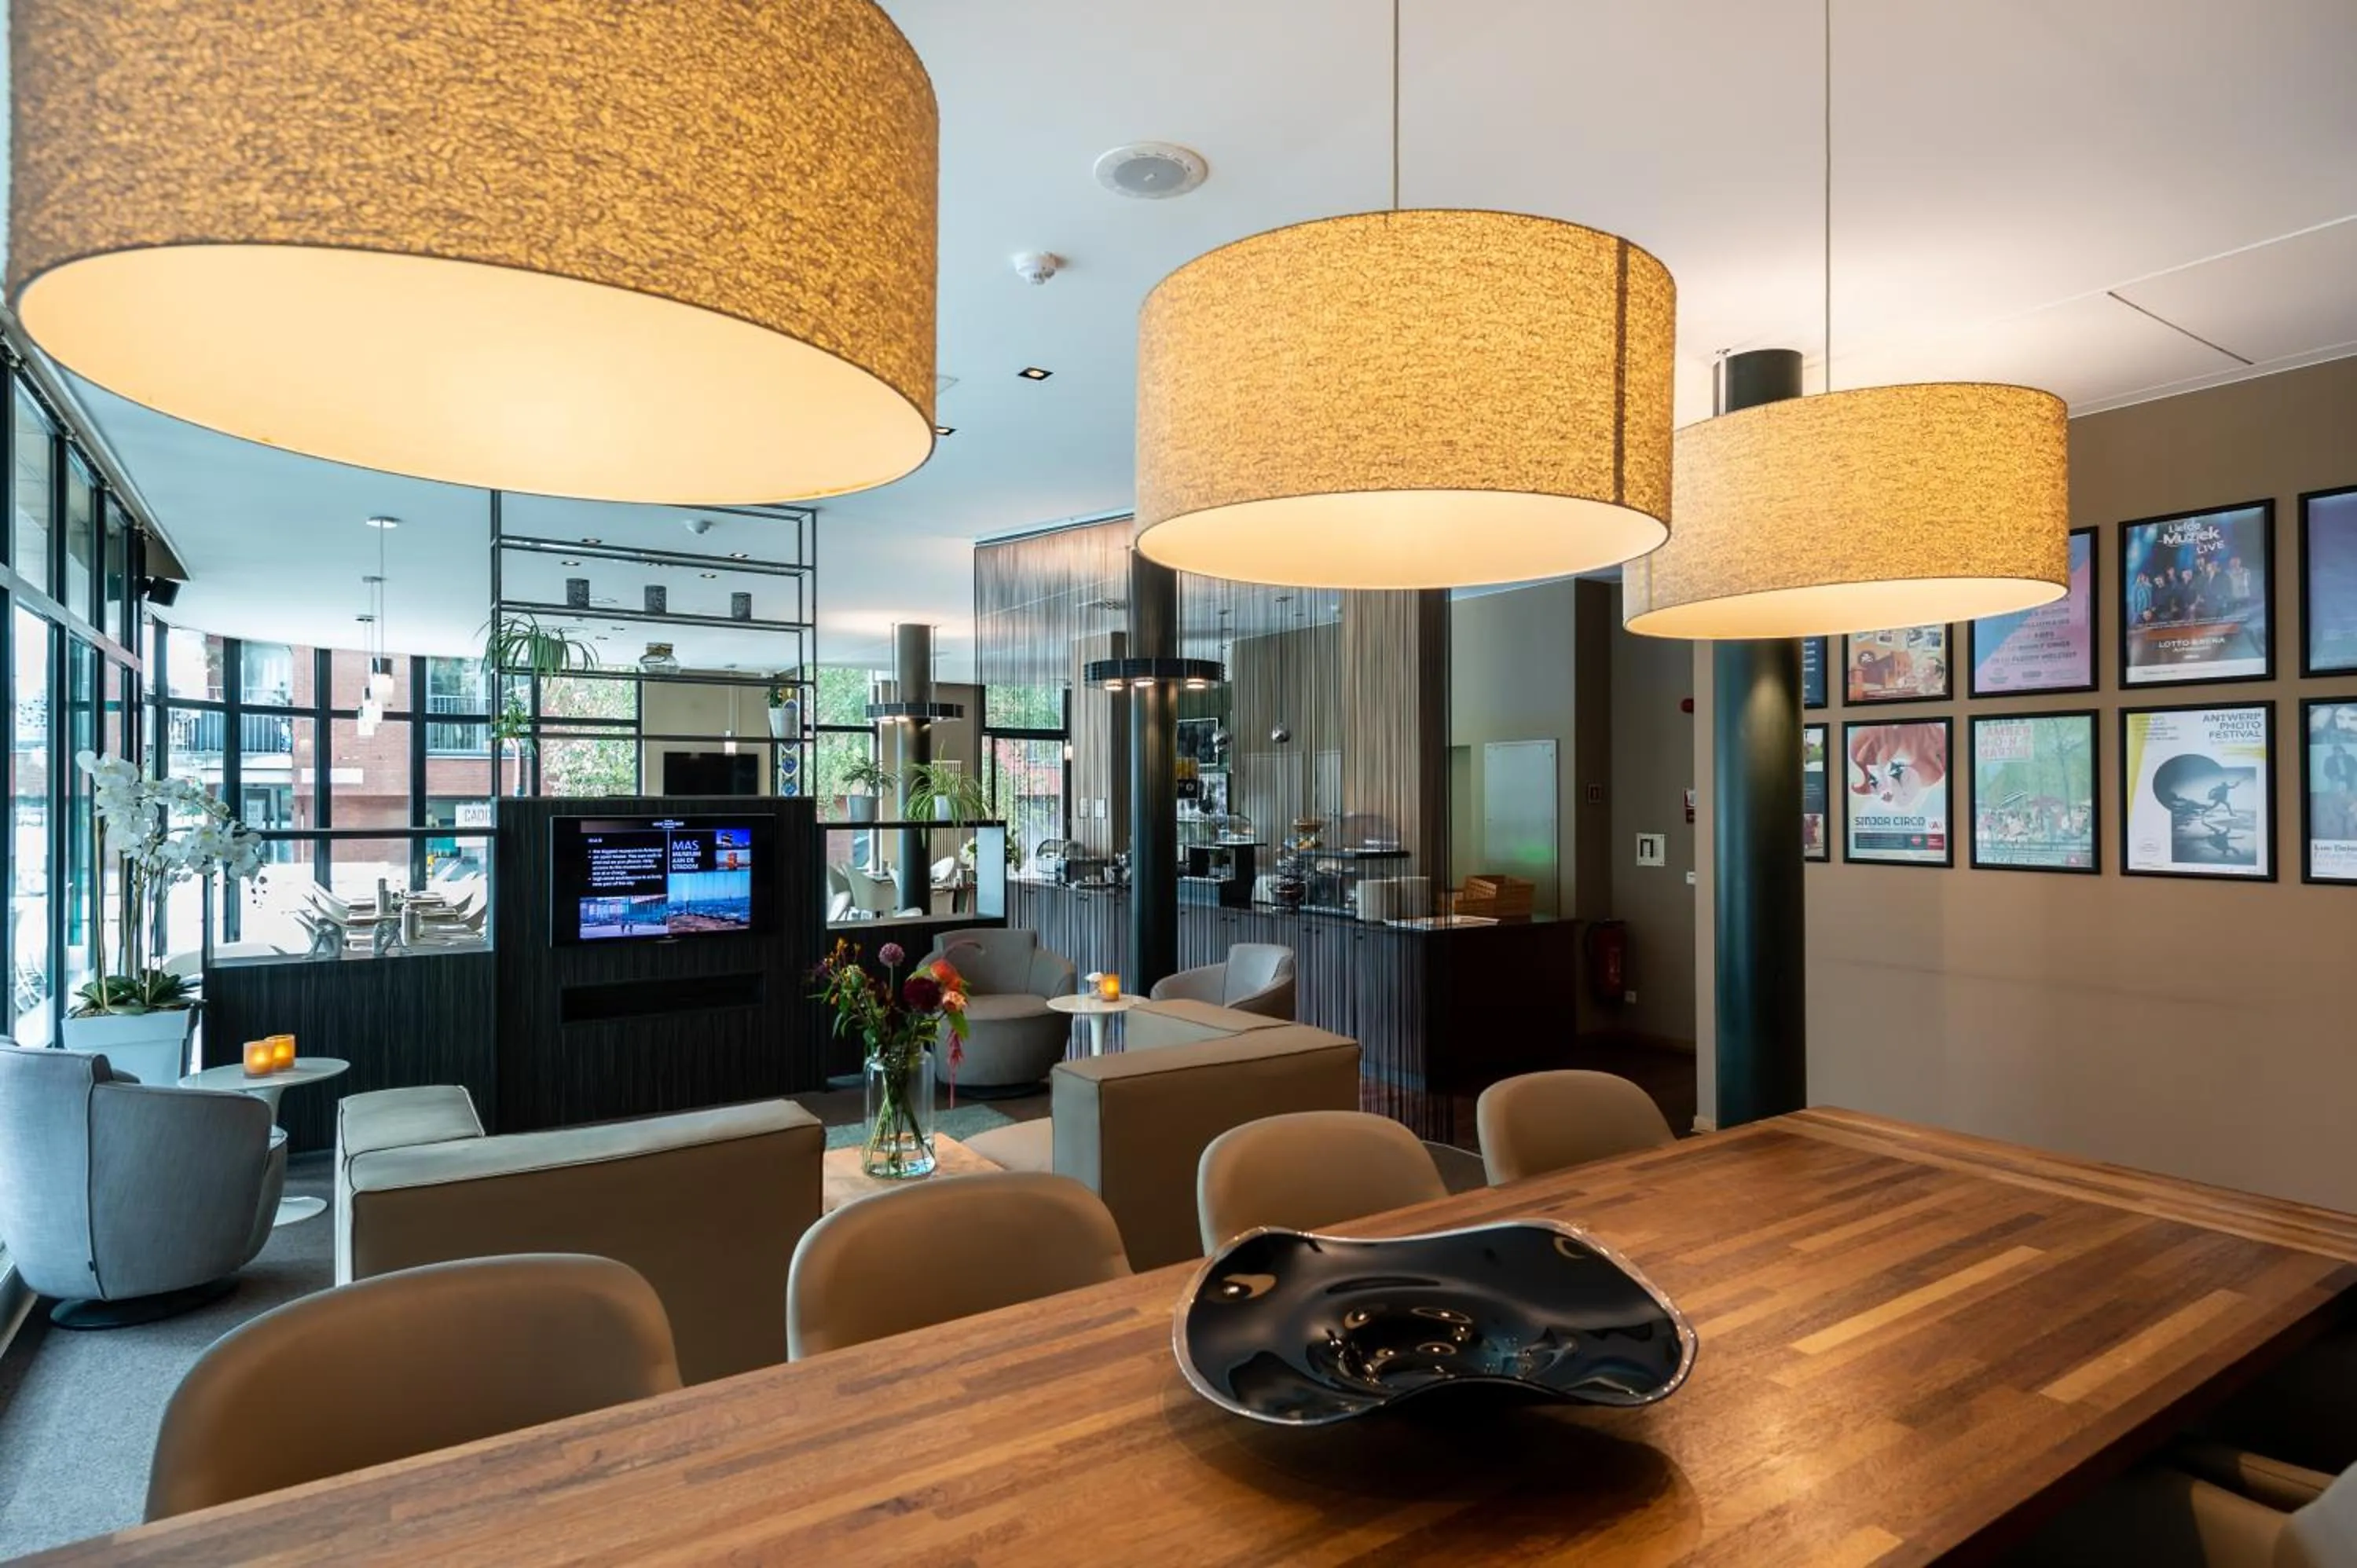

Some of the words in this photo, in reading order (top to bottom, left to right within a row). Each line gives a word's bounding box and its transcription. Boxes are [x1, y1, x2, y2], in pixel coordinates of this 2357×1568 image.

[2203, 713, 2262, 722] ANTWERP
[2220, 721, 2262, 730] PHOTO
[2209, 730, 2263, 739] FESTIVAL
[672, 840, 699, 851] MAS
